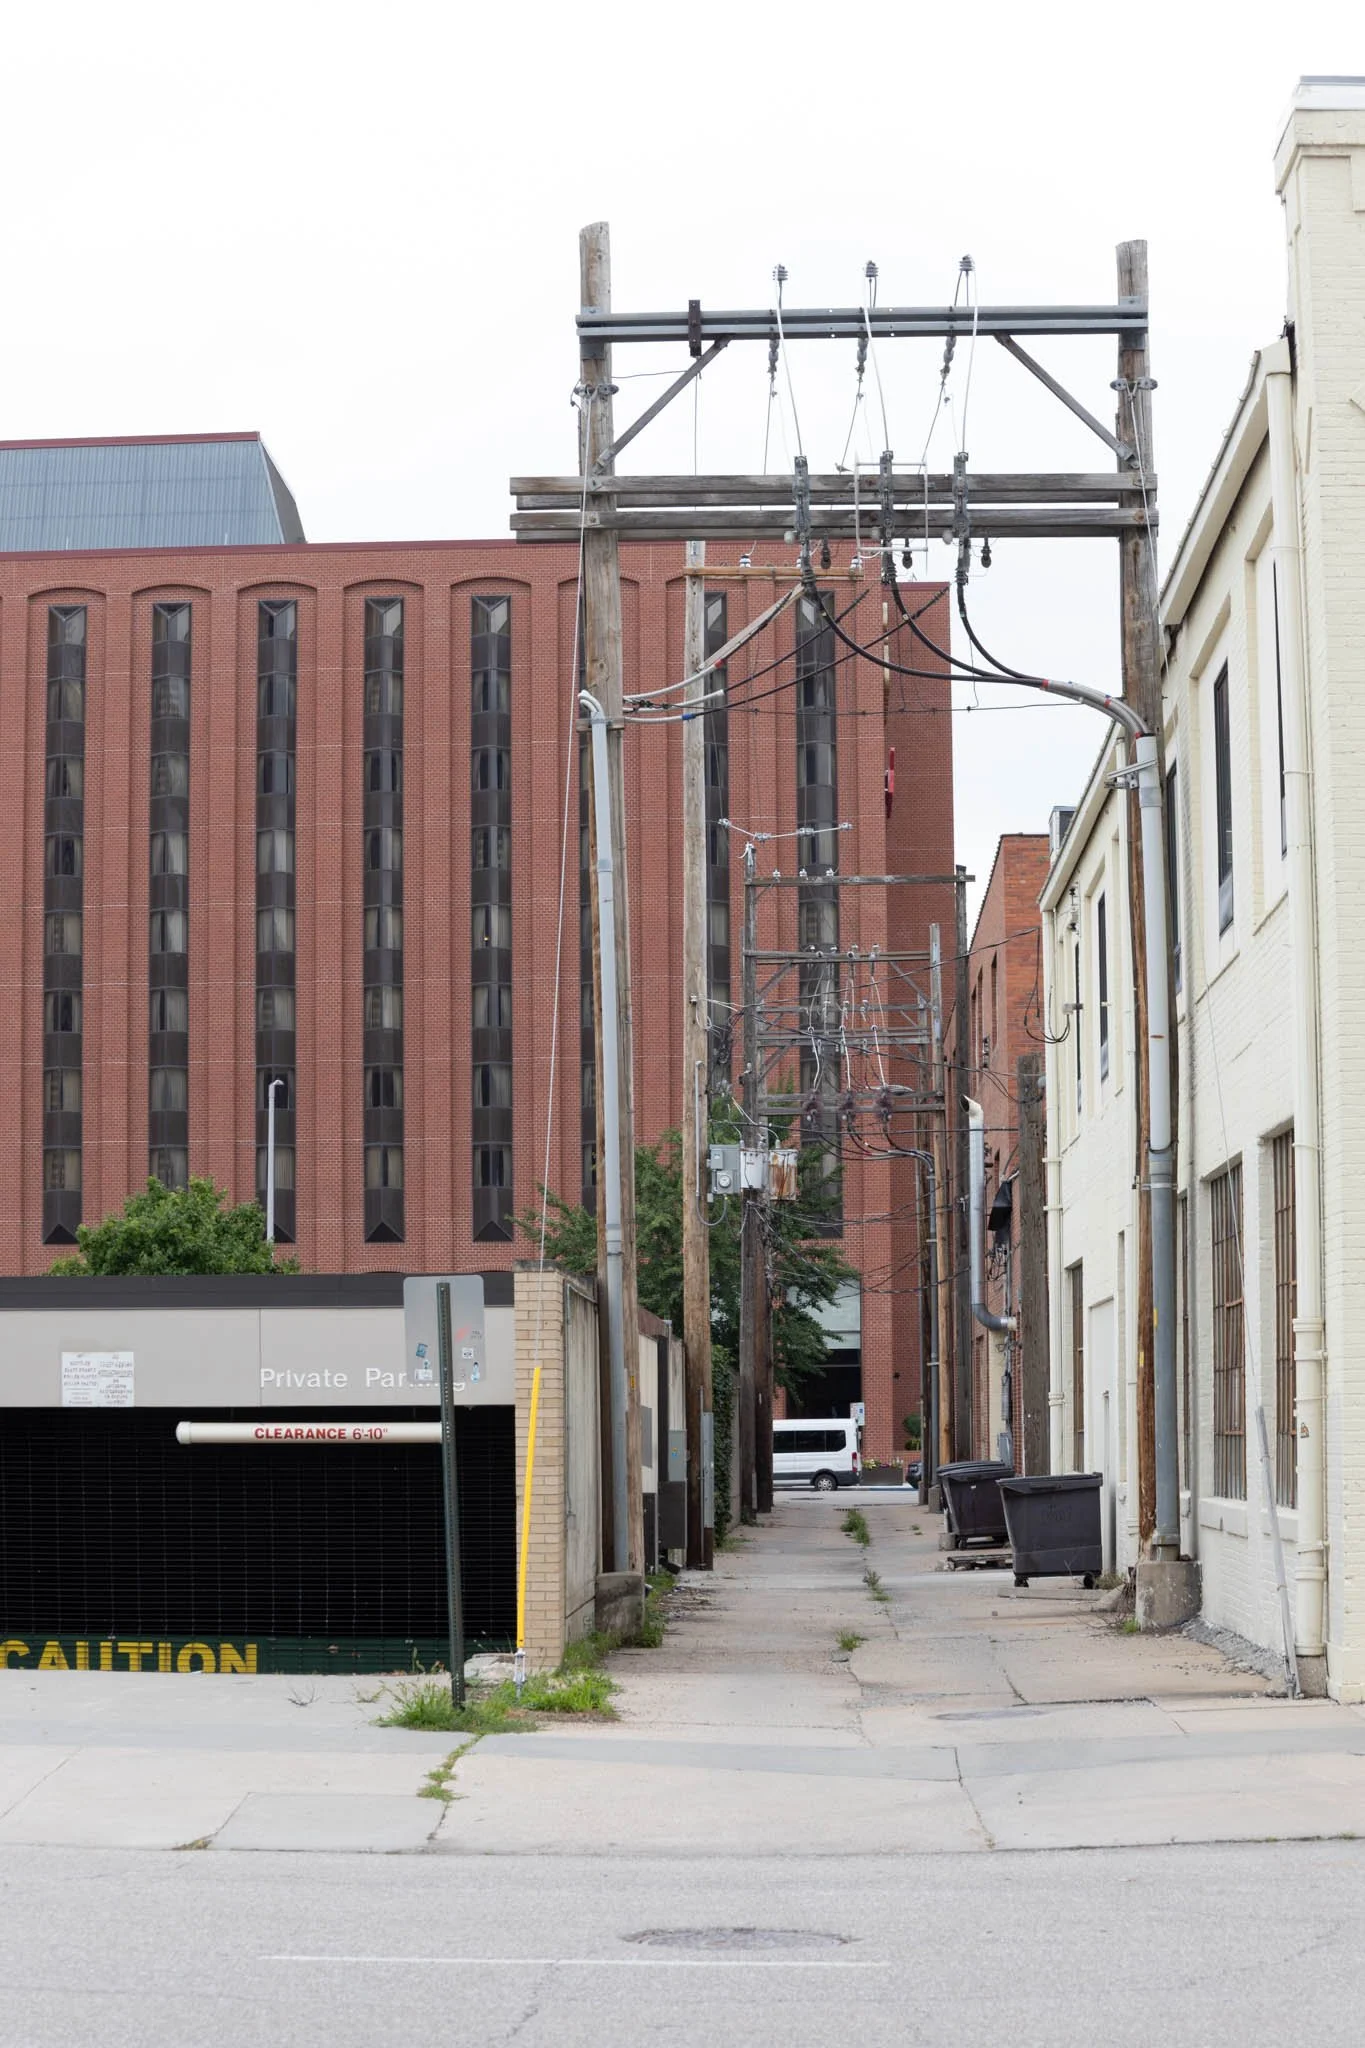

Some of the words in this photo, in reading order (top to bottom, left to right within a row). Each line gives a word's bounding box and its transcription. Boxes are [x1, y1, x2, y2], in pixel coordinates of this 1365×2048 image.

[260, 1367, 348, 1388] Private
[254, 1428, 347, 1440] CLEARANCE
[0, 1640, 258, 1674] CAUTION
